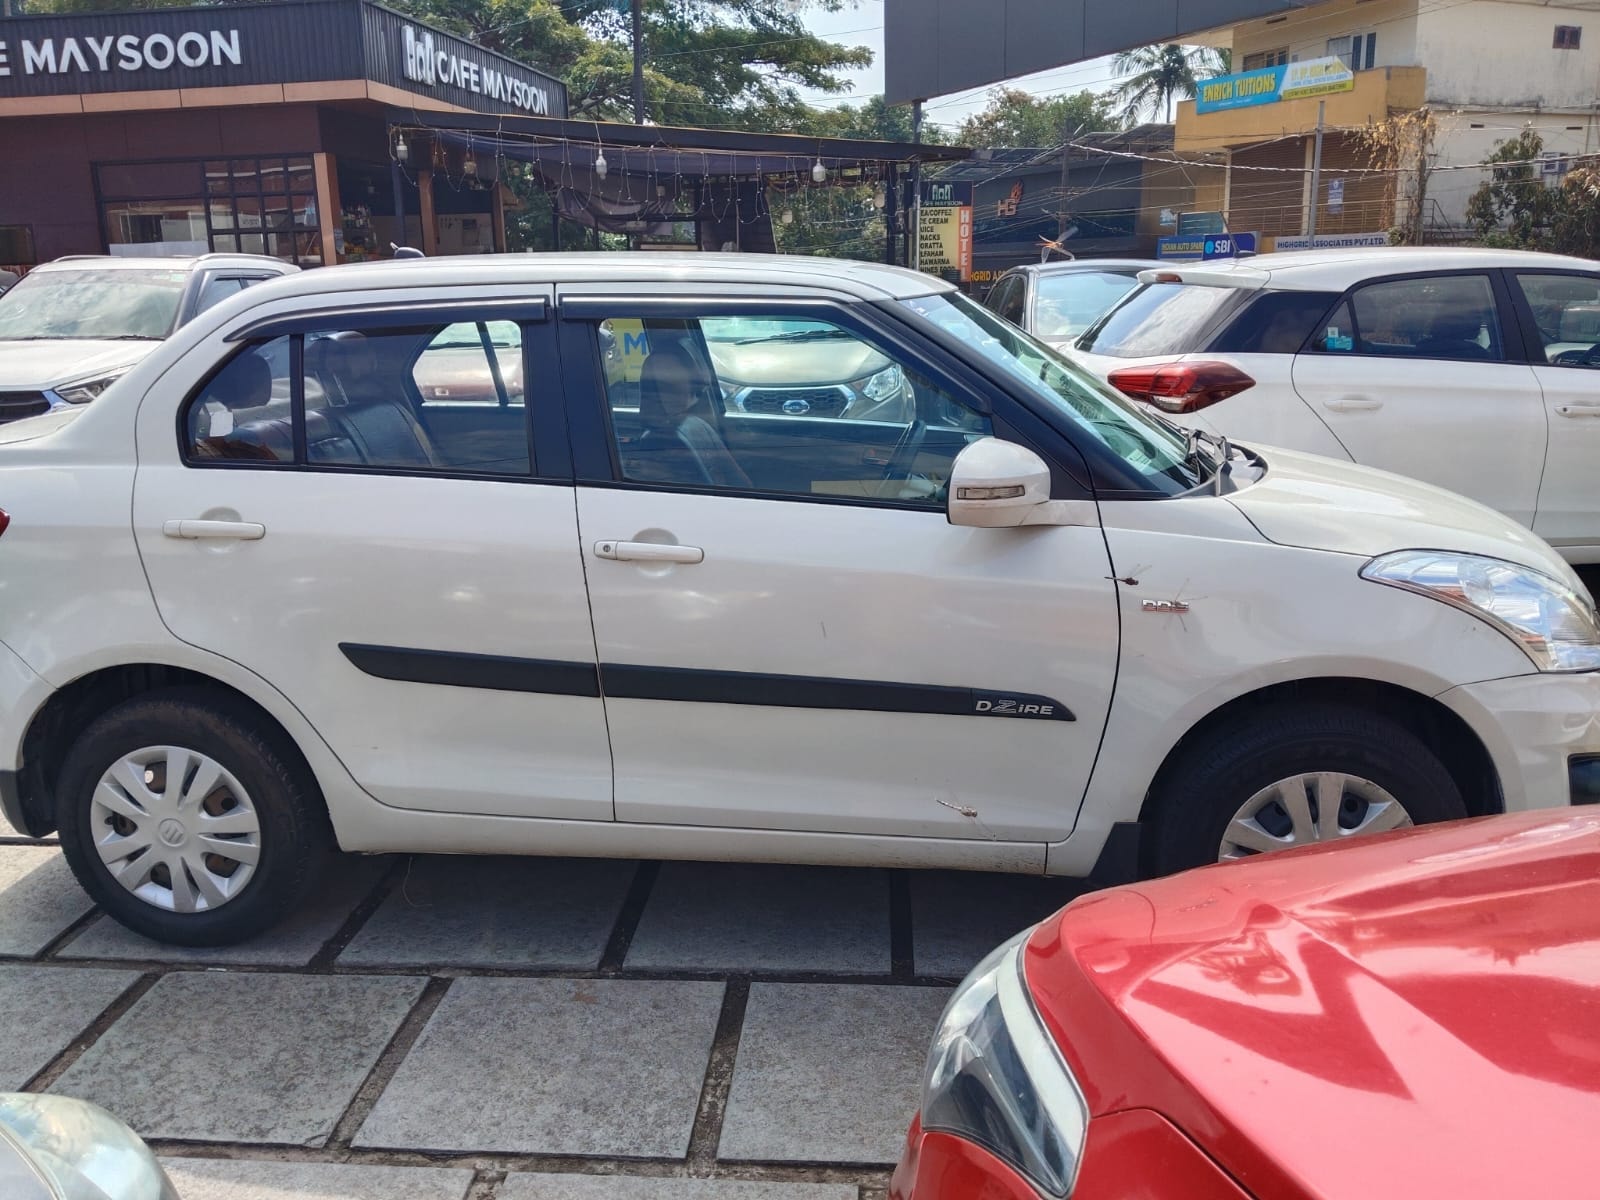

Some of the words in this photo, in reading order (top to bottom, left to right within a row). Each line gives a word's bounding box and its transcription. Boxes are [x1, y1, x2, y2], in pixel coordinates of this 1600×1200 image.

[21, 29, 242, 75] MAYSOON
[436, 50, 480, 93] CAFE
[483, 66, 548, 115] MAYSOON
[1203, 81, 1233, 103] ENRICH
[1235, 73, 1276, 97] TUITIONS
[1214, 239, 1231, 254] SBI
